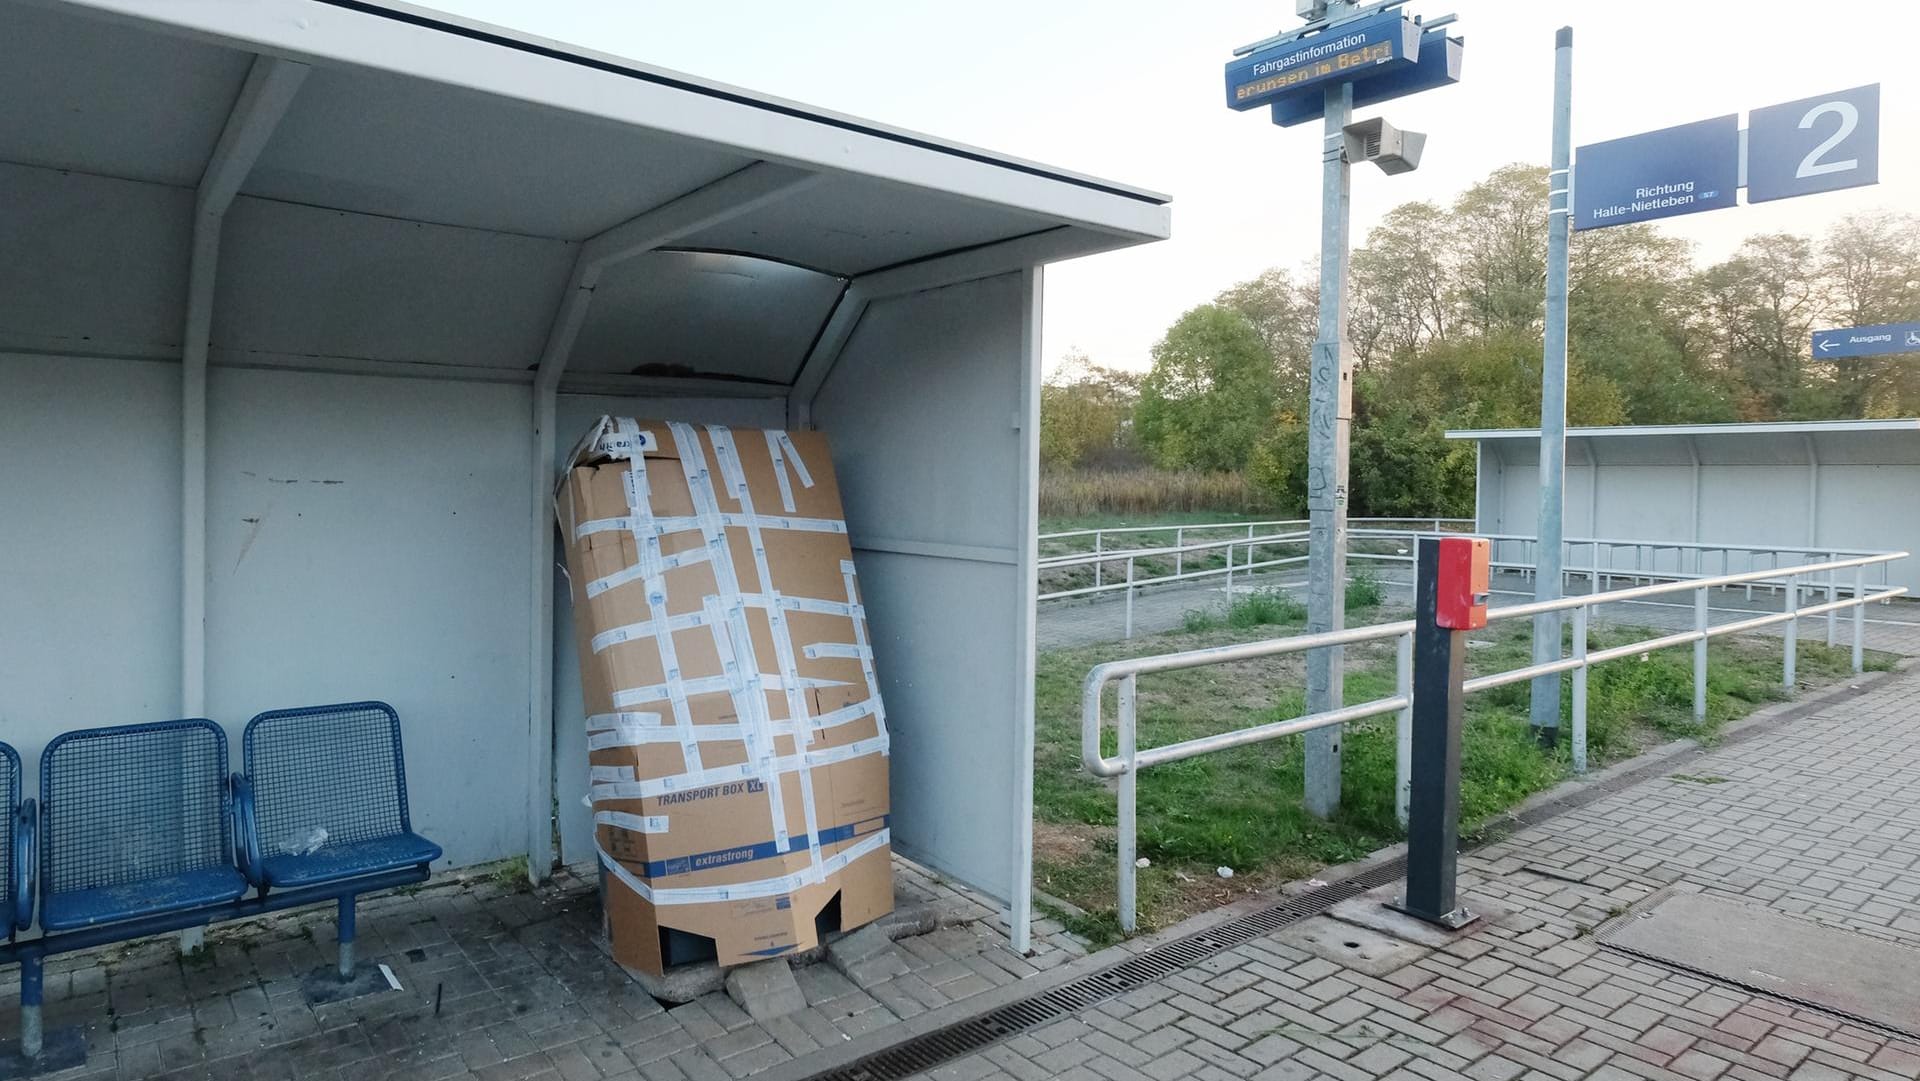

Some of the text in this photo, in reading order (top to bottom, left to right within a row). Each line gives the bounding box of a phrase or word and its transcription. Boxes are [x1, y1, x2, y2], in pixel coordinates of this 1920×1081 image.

[1253, 32, 1366, 77] Fahrgastinformation
[1315, 61, 1331, 76] im
[1337, 41, 1391, 69] Betri
[1796, 101, 1859, 179] 2
[1635, 180, 1695, 200] Richtung
[1593, 193, 1694, 220] Halle-Nietleben
[1849, 333, 1892, 344] Ausgang
[657, 780, 762, 807] TRANSPORT BOX XL
[695, 847, 754, 867] extrastrong
